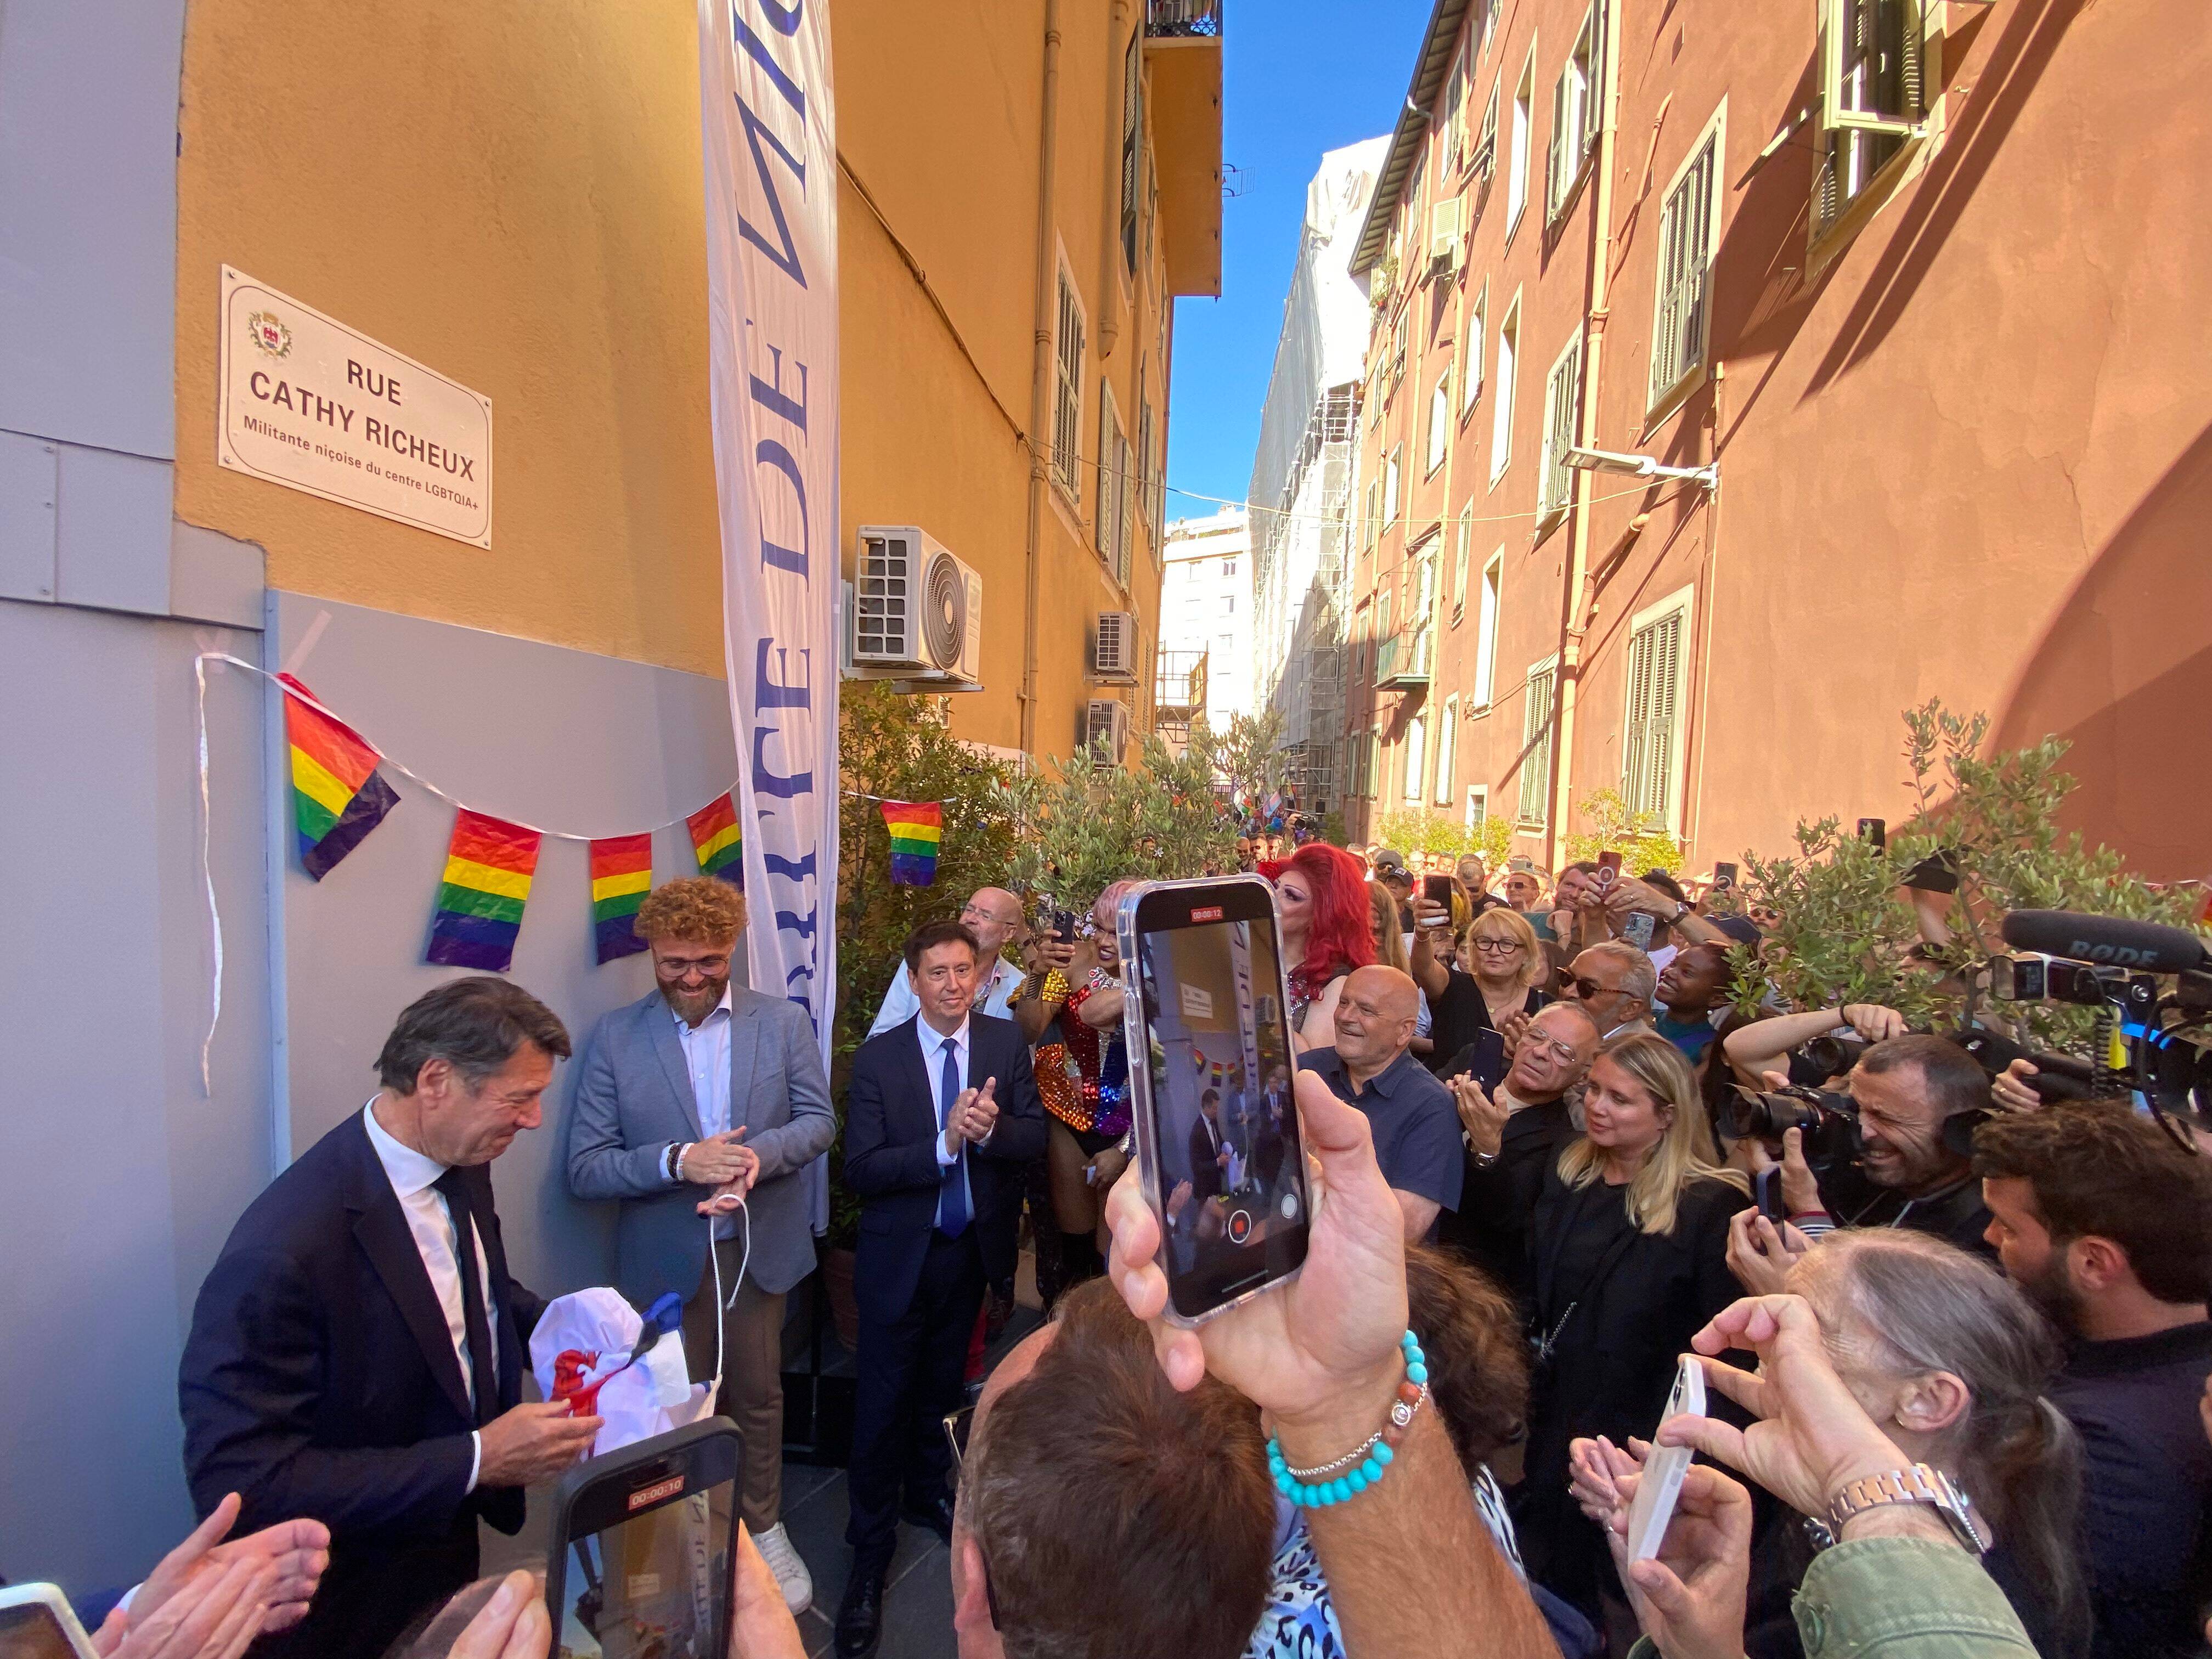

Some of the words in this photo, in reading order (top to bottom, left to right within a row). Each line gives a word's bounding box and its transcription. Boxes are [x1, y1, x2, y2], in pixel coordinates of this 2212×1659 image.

[347, 358, 402, 407] RUE
[250, 371, 354, 432] CATHY
[365, 416, 475, 482] RICHEUX
[244, 415, 311, 450] Militante
[315, 443, 362, 469] niçoise
[366, 461, 381, 476] du
[385, 470, 422, 490] centre
[425, 481, 479, 511] LGBTQIA+
[1193, 909, 1221, 919] 00:00:12
[632, 1480, 681, 1505] 00:00:10
